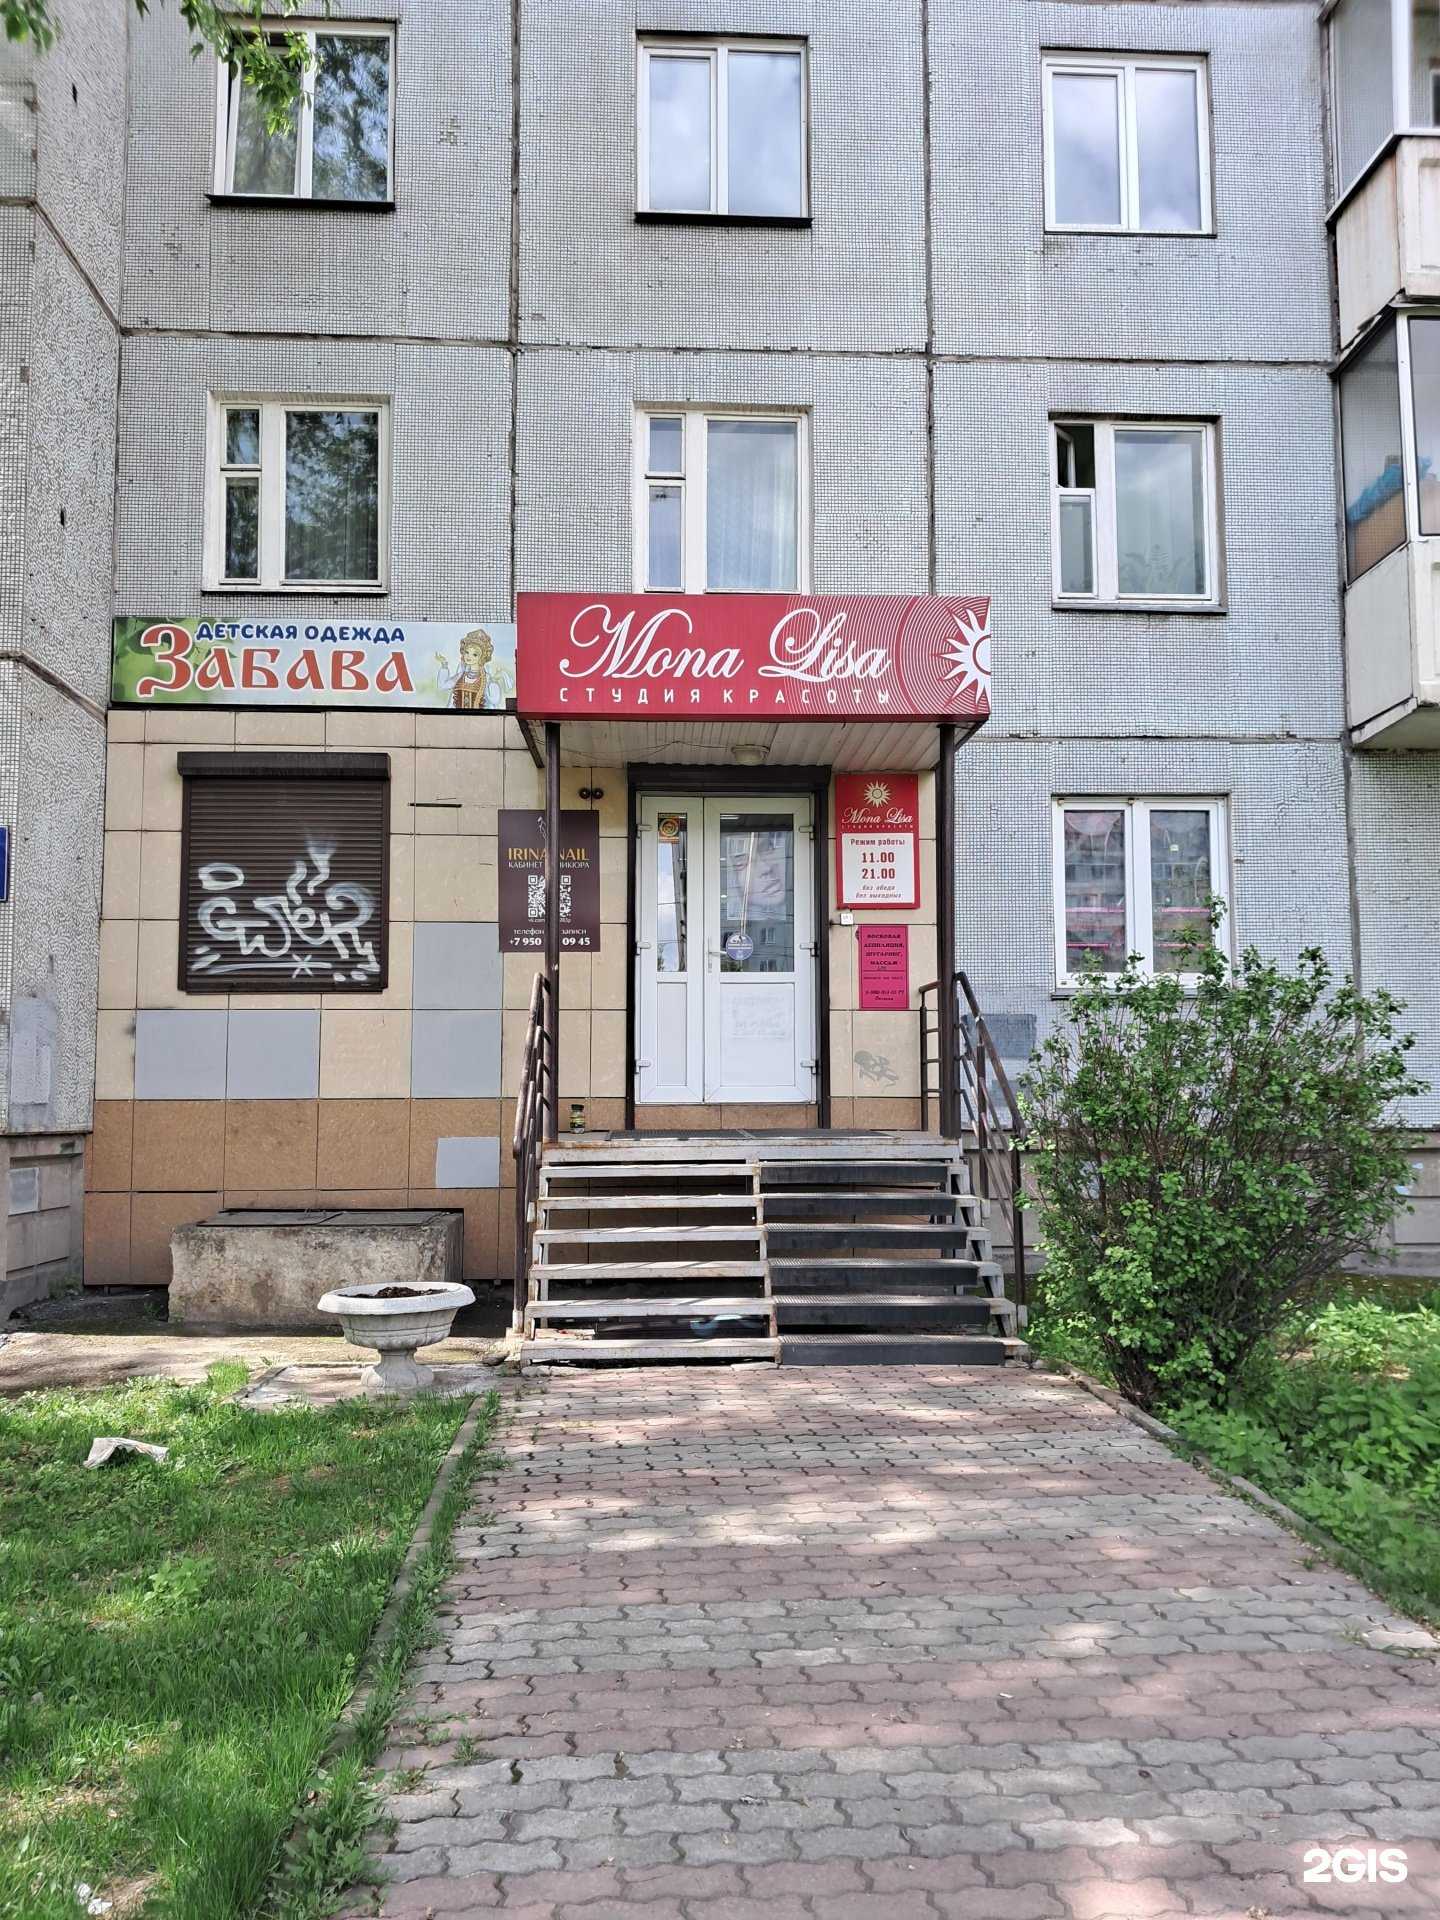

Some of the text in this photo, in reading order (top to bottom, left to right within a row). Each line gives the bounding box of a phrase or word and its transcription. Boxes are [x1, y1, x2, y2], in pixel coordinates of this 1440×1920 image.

[196, 623, 405, 644] ДЕТСКАЯ ОДЕЖДА
[559, 604, 892, 683] Mona Lisa
[138, 624, 414, 696] ЗАБАВА
[559, 688, 889, 704] СТУДИЯ КРАСОТЫ
[842, 807, 913, 824] Mona Lisa
[850, 838, 905, 847] Режим работы
[862, 852, 895, 863] 11.00
[508, 861, 543, 869] КАБИНЕТ
[862, 868, 896, 879] 21.00
[510, 937, 591, 946] +7 950 09 45
